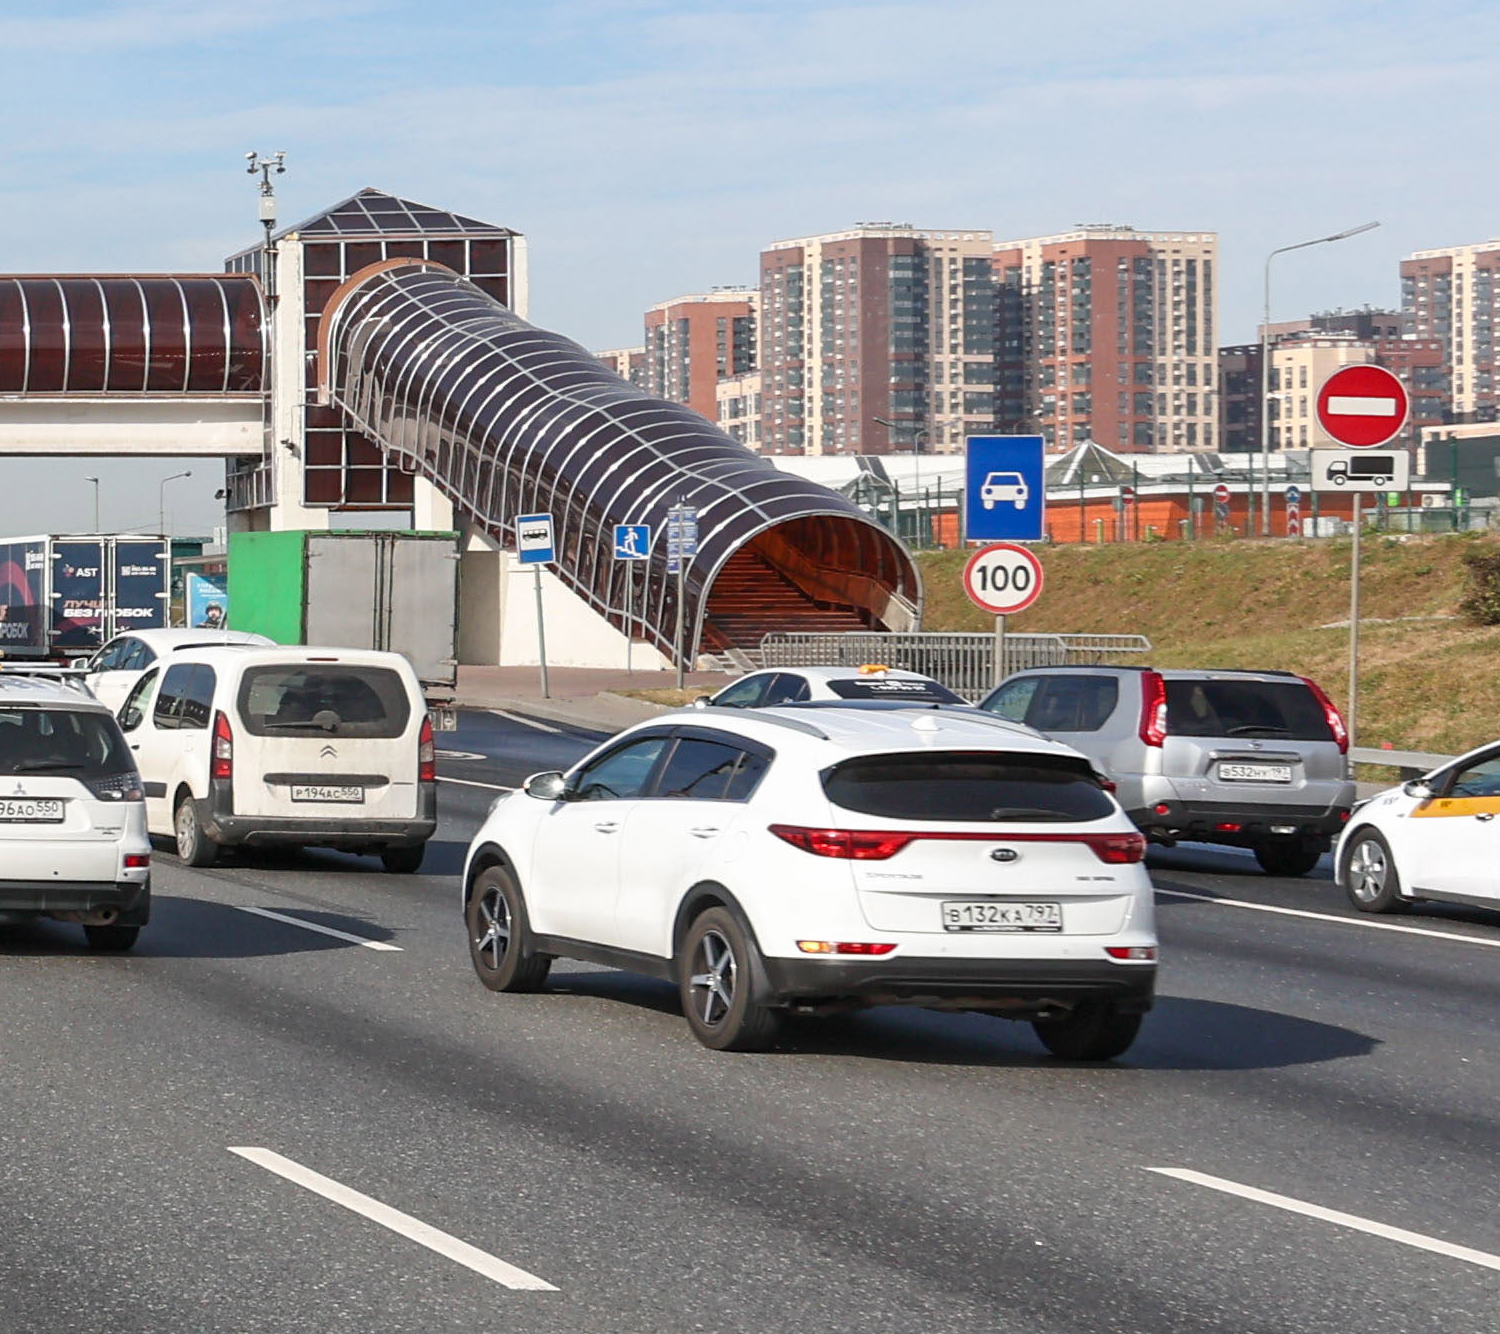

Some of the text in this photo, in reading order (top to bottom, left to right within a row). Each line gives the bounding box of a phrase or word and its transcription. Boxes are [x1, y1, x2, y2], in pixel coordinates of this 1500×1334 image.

[76, 567, 99, 578] AST
[976, 565, 1031, 592] 100
[63, 608, 94, 618] БЕЗ
[950, 905, 1054, 924] В132КА 797
